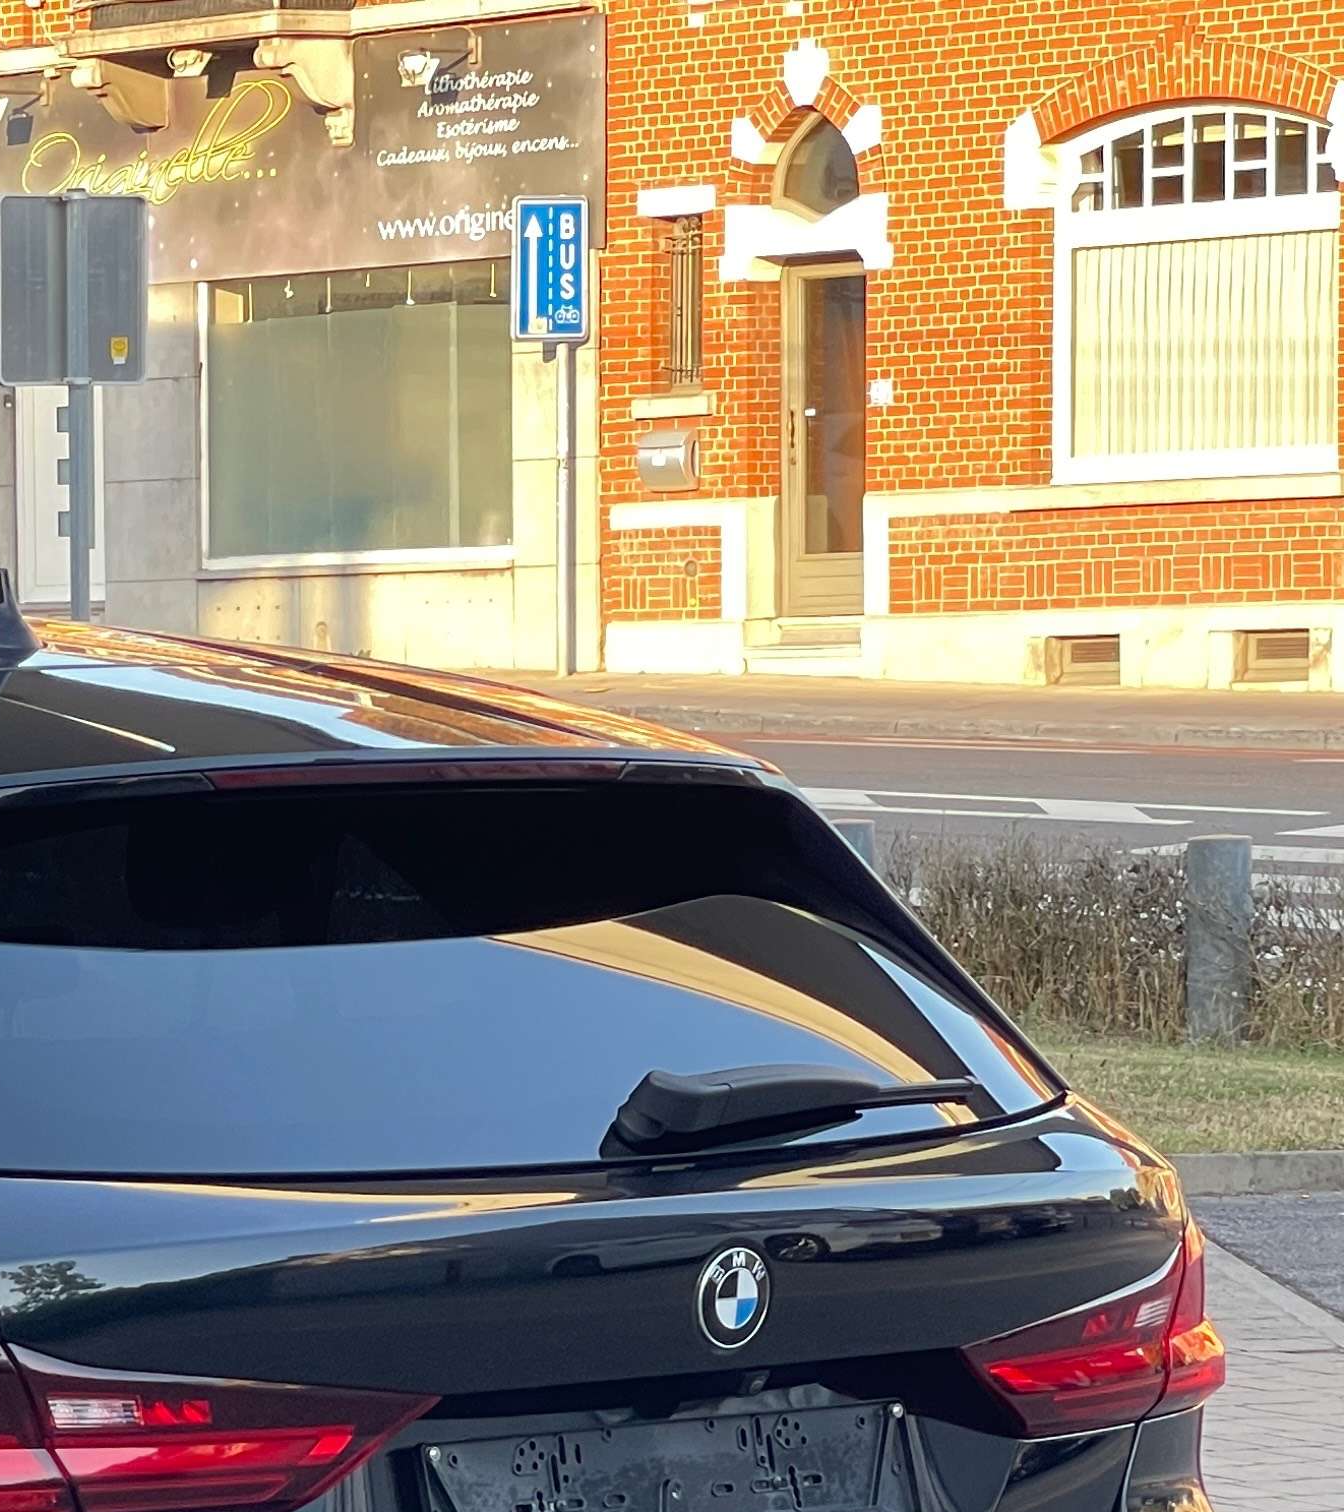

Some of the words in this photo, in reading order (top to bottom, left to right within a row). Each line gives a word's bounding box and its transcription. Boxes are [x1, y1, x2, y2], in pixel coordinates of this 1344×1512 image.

[417, 91, 540, 118] Aromathérapie
[436, 117, 520, 138] Esotérisme
[559, 212, 576, 300] BUS
